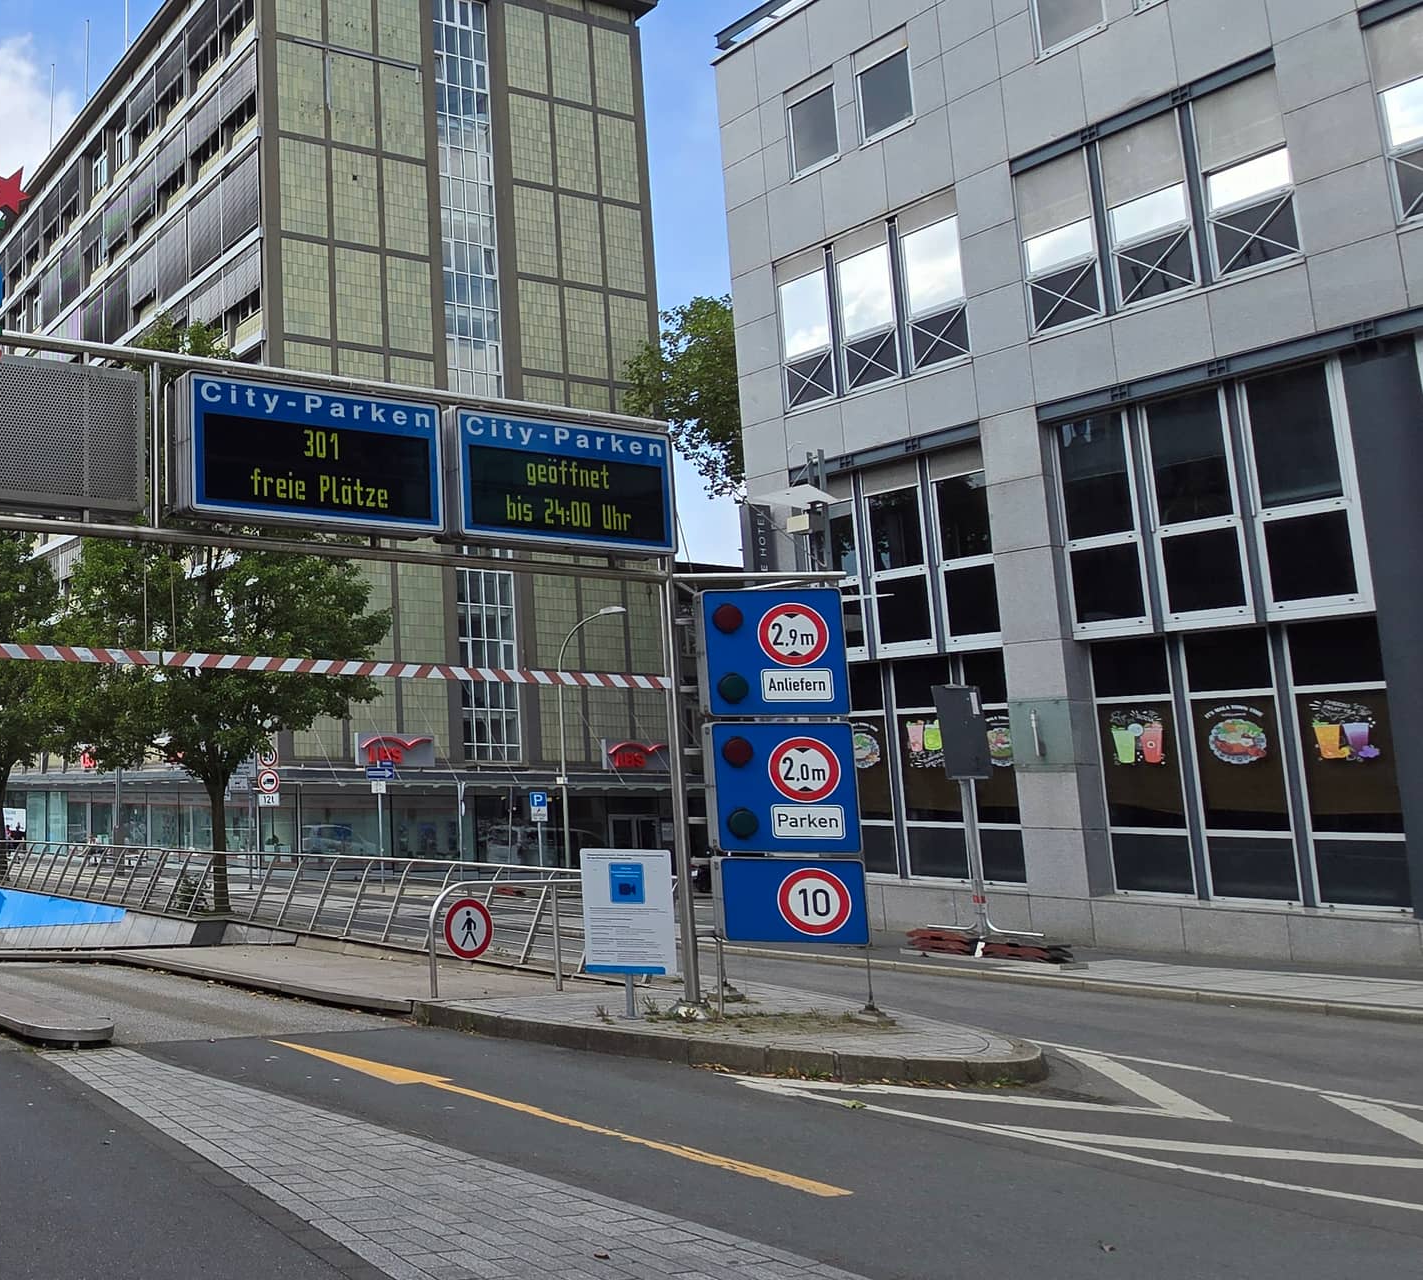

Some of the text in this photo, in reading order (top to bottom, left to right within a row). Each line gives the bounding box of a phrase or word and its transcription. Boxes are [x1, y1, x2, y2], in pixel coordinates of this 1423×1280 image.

[199, 379, 433, 430] City-Parken
[303, 429, 341, 461] 301
[465, 415, 664, 458] City-Parken
[250, 468, 390, 510] freie Plätze
[526, 457, 611, 490] geöffnet
[506, 494, 633, 532] bis 24:00 Uhr
[768, 677, 827, 693] Anliefern
[533, 794, 543, 806] P
[777, 813, 840, 829] Parken
[798, 889, 832, 917] 10
